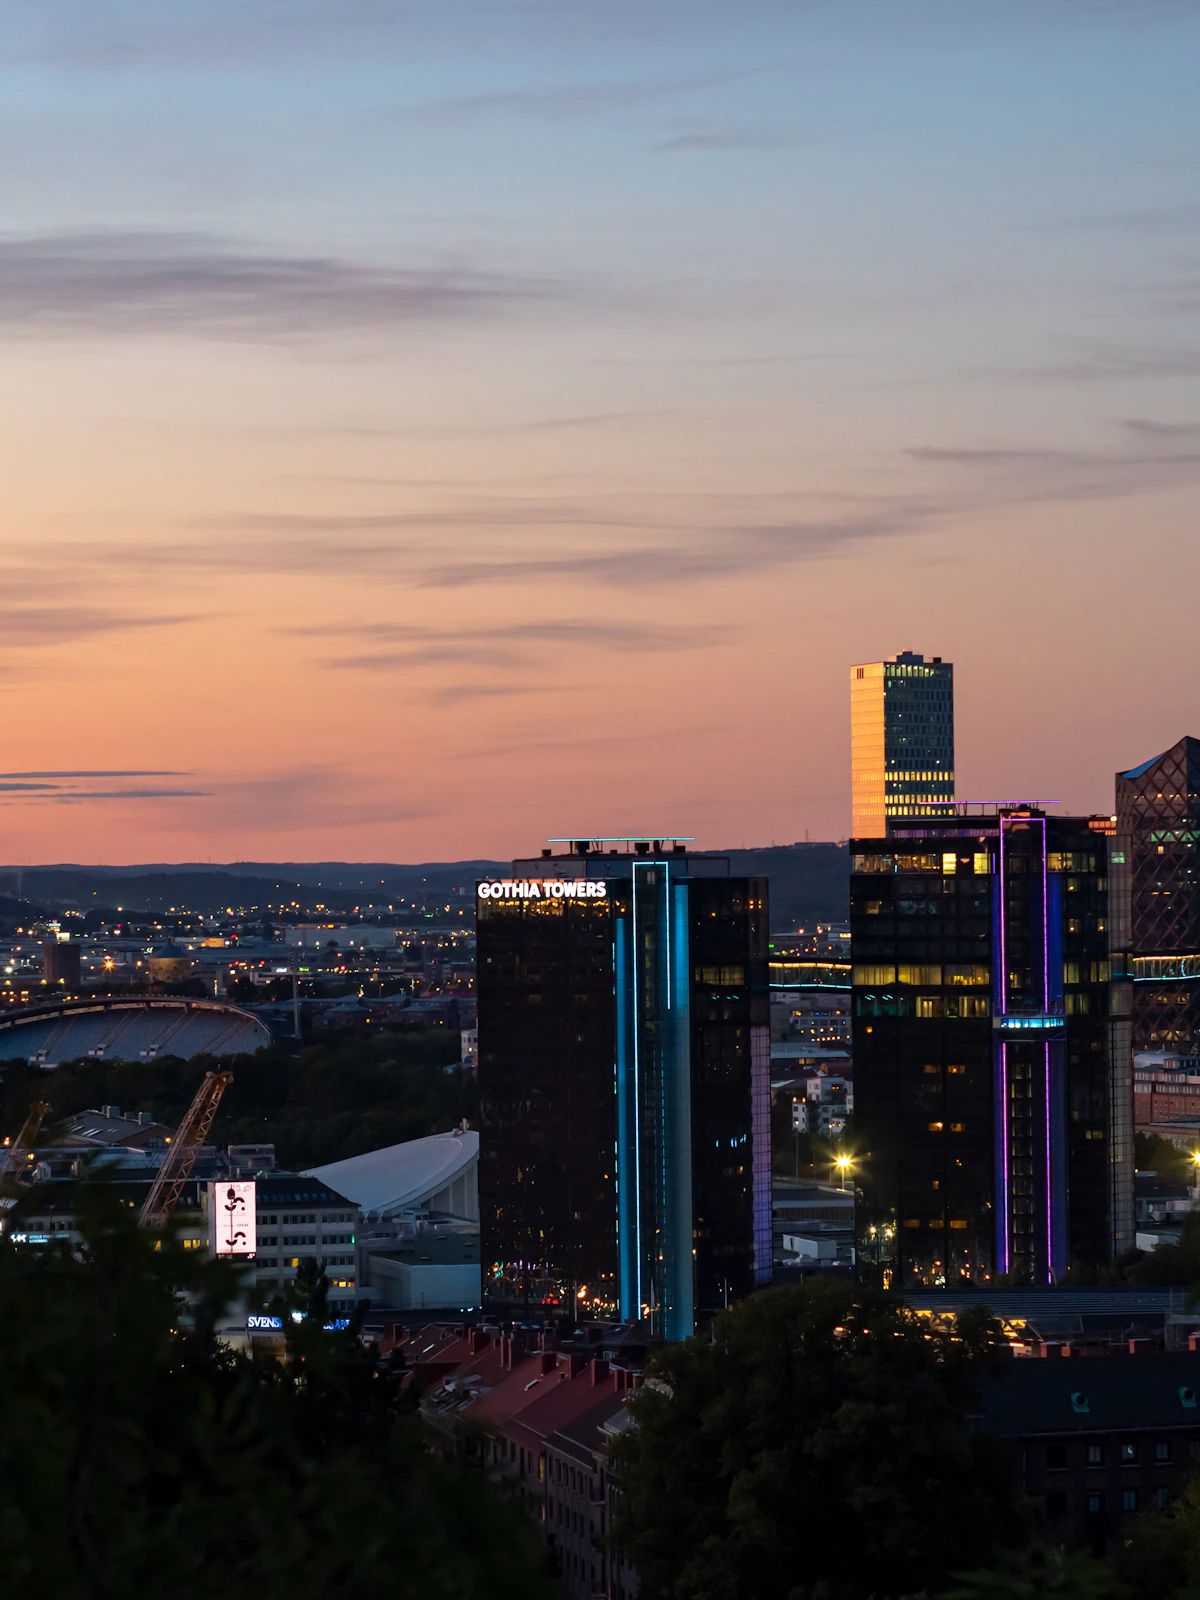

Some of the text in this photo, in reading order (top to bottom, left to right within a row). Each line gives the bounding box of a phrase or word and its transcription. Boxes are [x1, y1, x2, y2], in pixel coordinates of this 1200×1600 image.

[477, 881, 607, 898] GOTHIA TOWERS
[248, 1316, 282, 1328] SVENS
